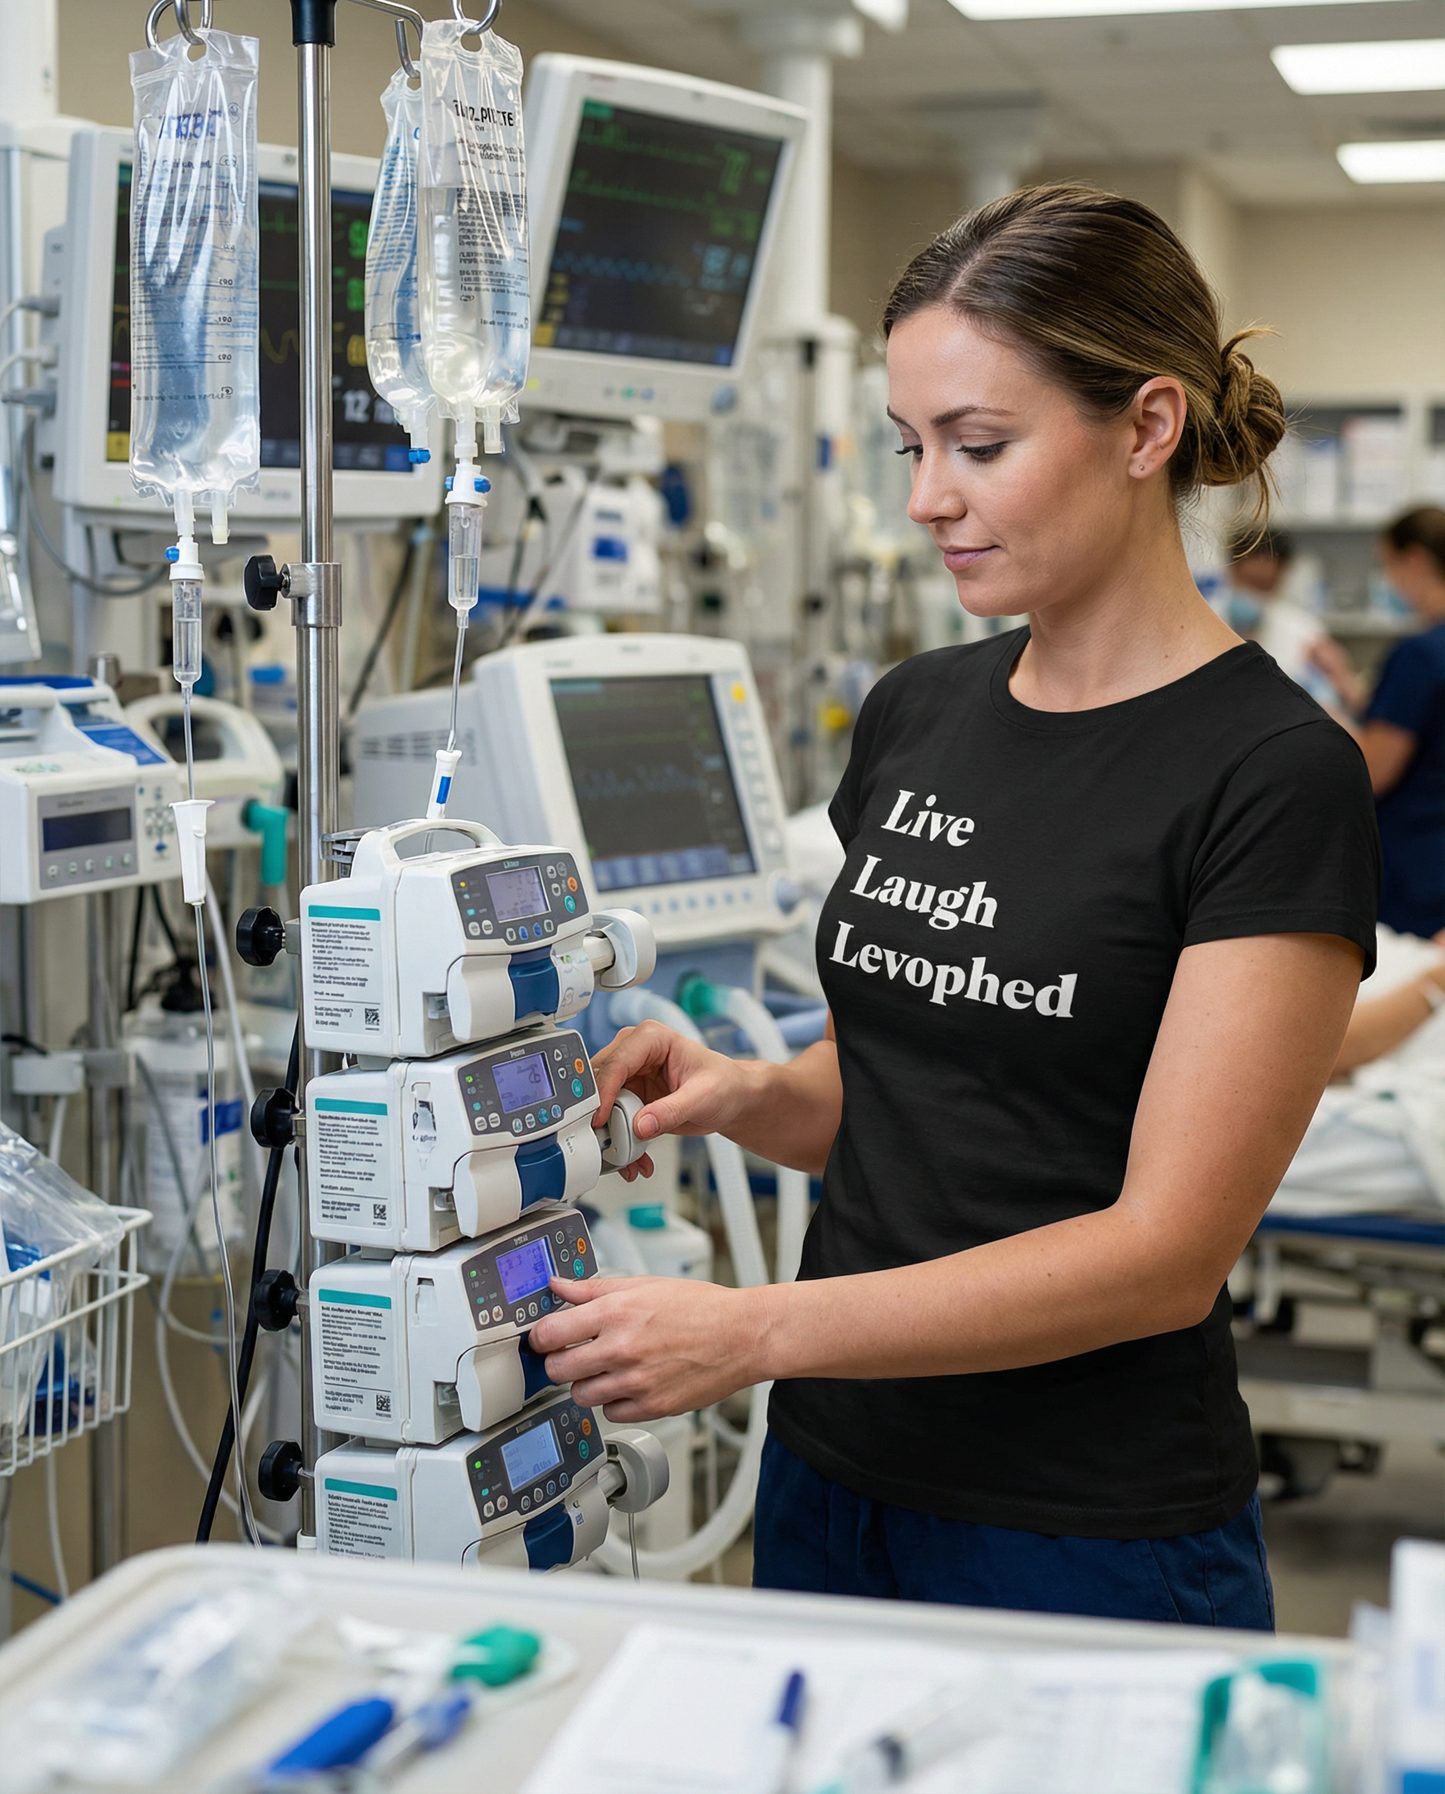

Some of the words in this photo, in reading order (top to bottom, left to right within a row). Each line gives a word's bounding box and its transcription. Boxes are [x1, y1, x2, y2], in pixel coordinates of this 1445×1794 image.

[881, 789, 975, 848] Live
[850, 854, 998, 931] Laugh
[829, 920, 1078, 1019] Levophed
